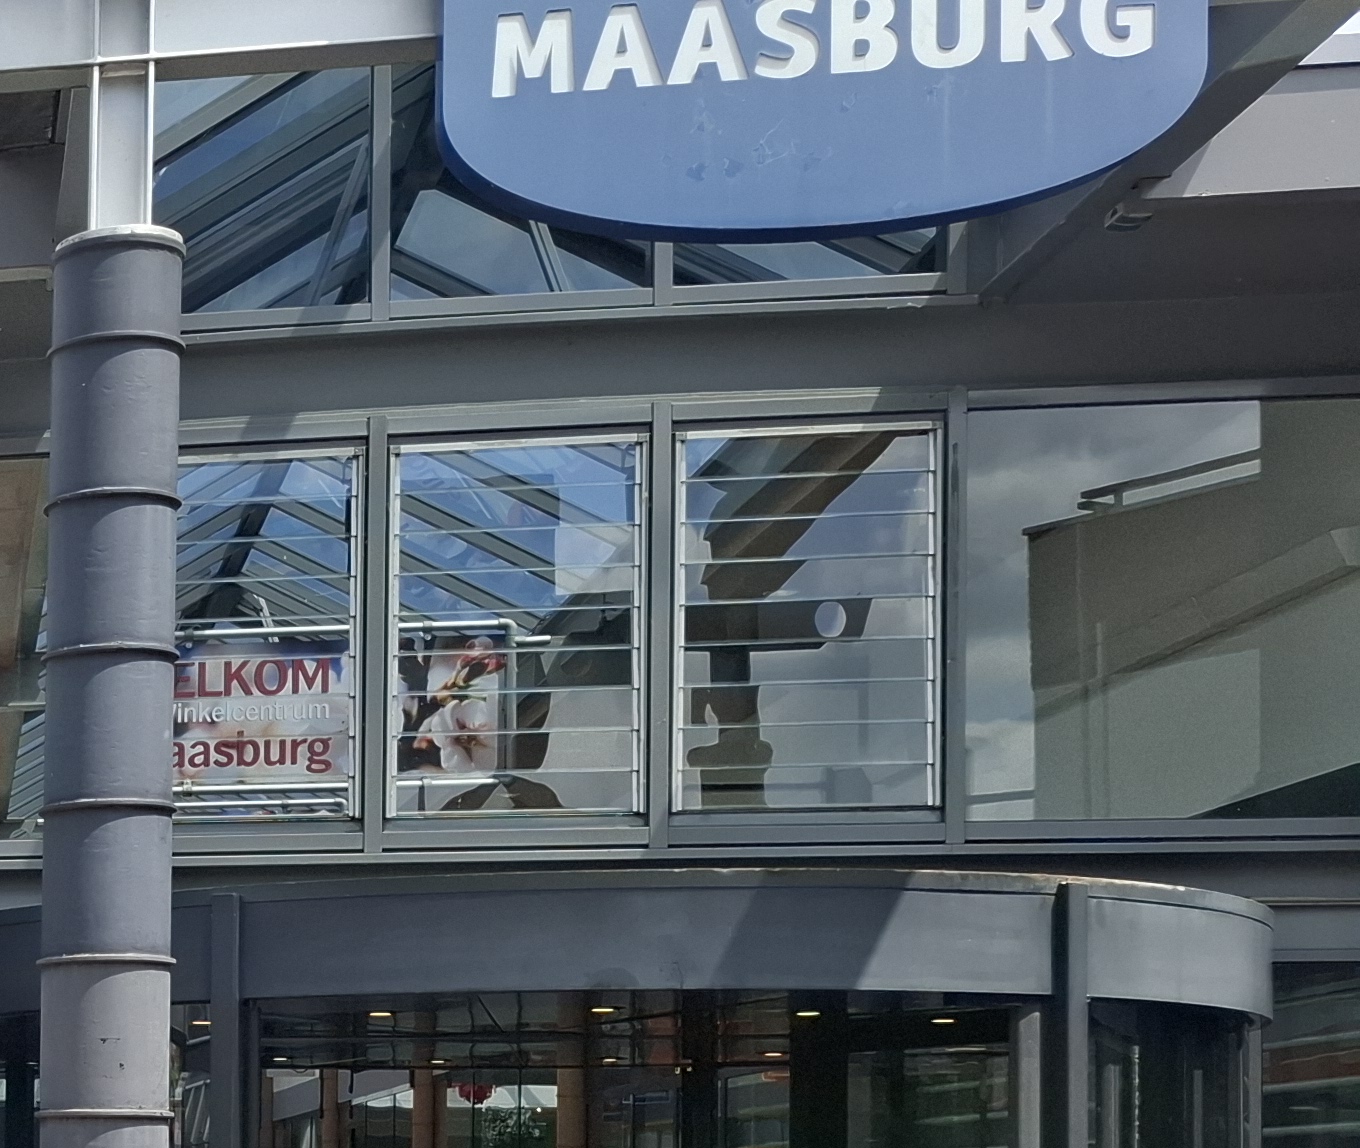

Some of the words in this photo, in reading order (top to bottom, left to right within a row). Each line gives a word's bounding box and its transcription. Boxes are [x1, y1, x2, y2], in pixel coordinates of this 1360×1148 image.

[491, 0, 1156, 98] MAASBURG
[174, 657, 330, 698] ELKOM
[173, 702, 330, 723] inkelcentrum
[173, 731, 332, 773] aasburg
